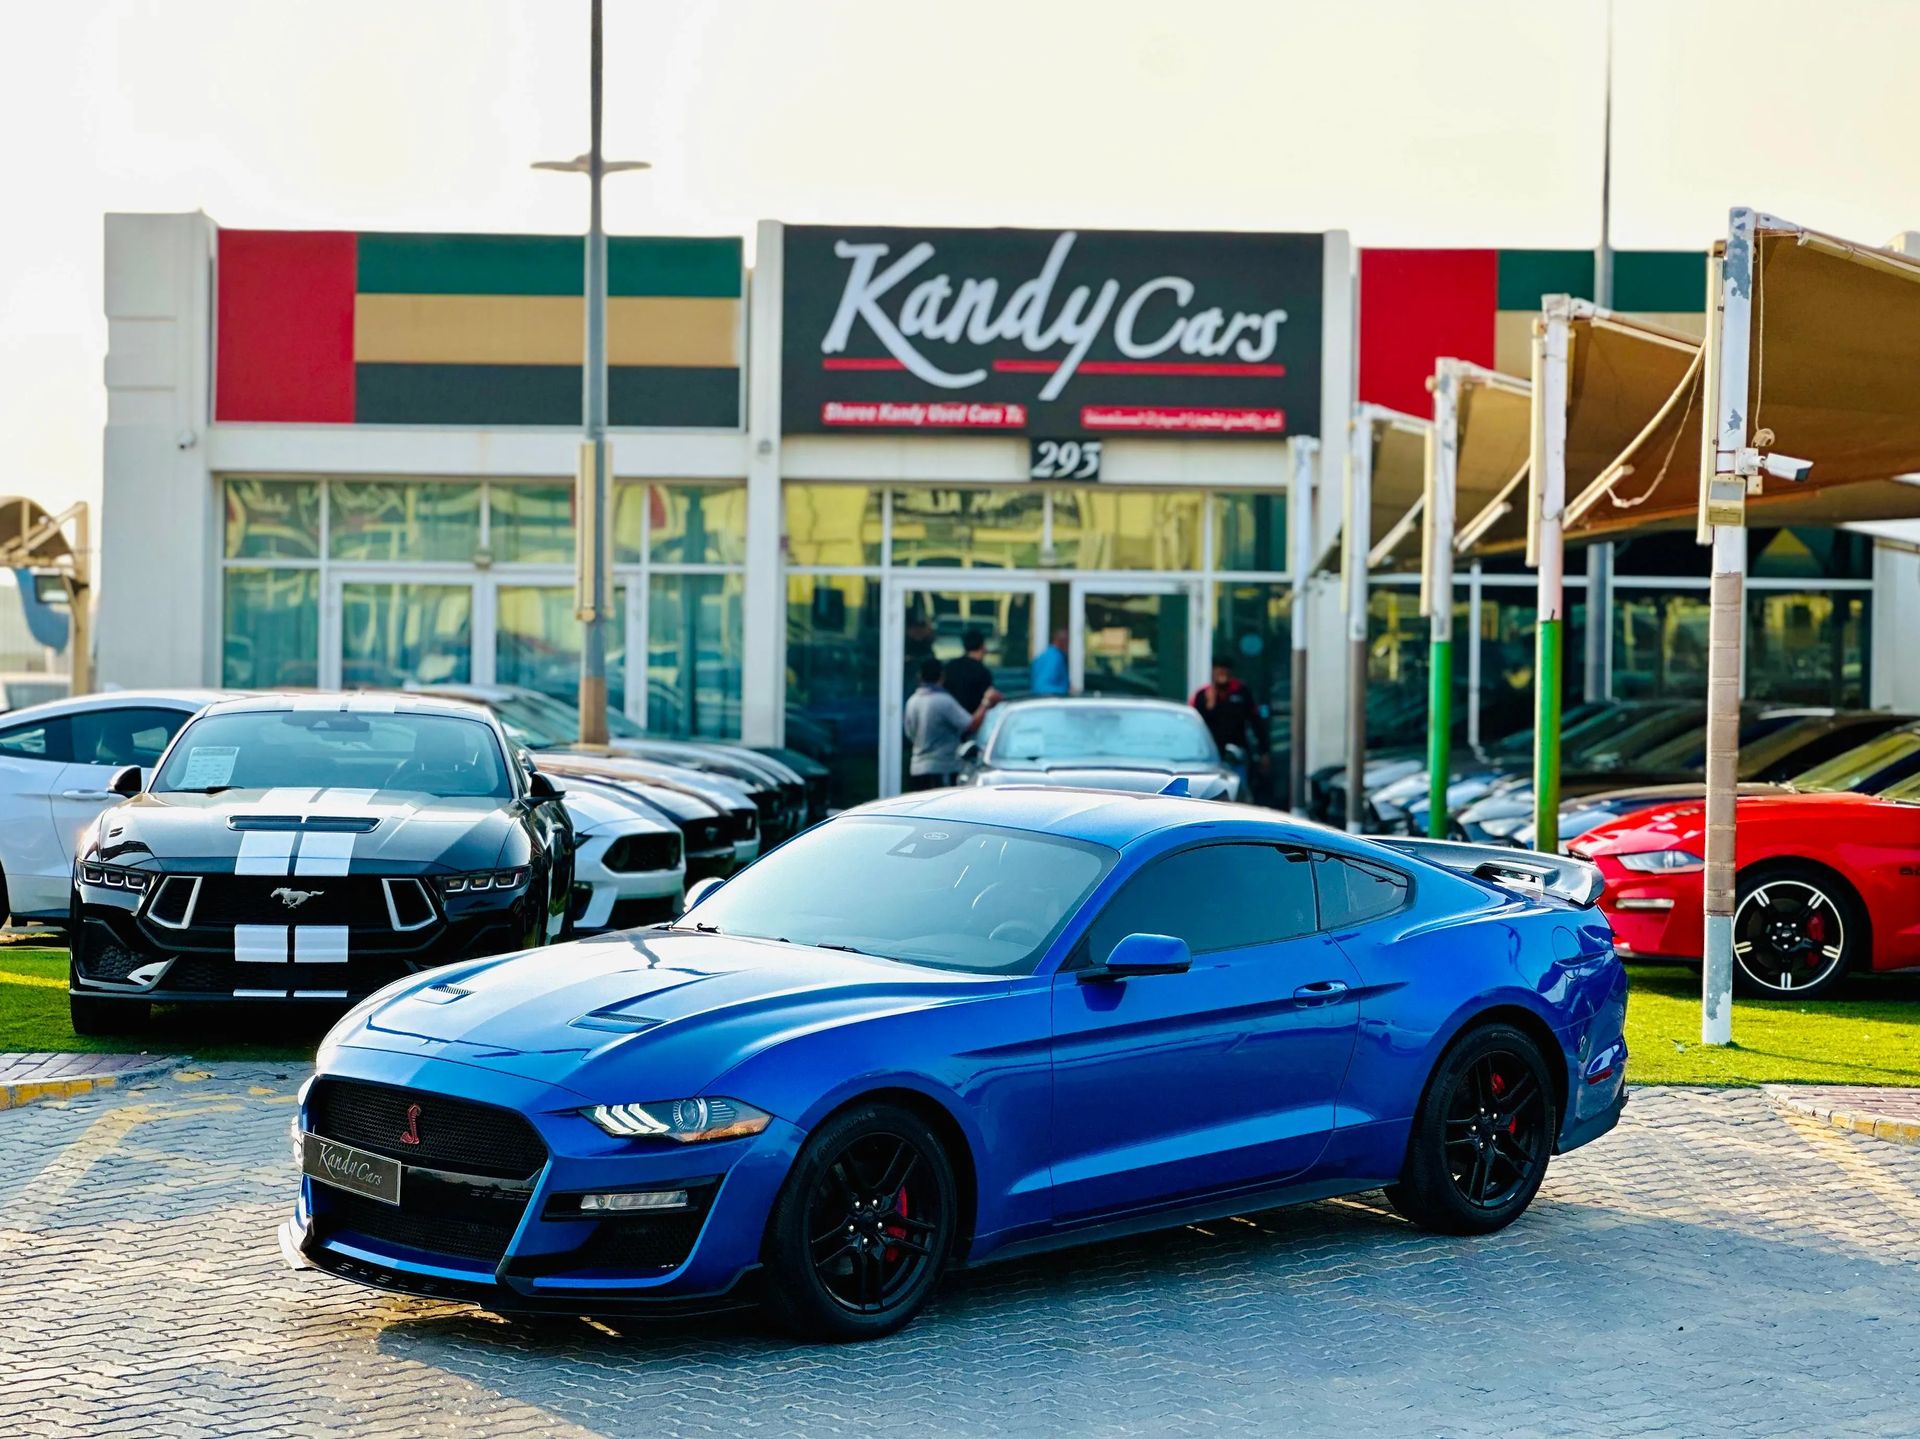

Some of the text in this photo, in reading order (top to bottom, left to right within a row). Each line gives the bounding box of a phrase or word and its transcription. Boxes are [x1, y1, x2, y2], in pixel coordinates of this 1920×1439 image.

[821, 231, 1287, 400] Kandy Cars
[878, 403, 926, 425] Kandy
[927, 404, 968, 422] Used
[967, 404, 1003, 423] Cars
[318, 1143, 383, 1186] Kandy Cars
